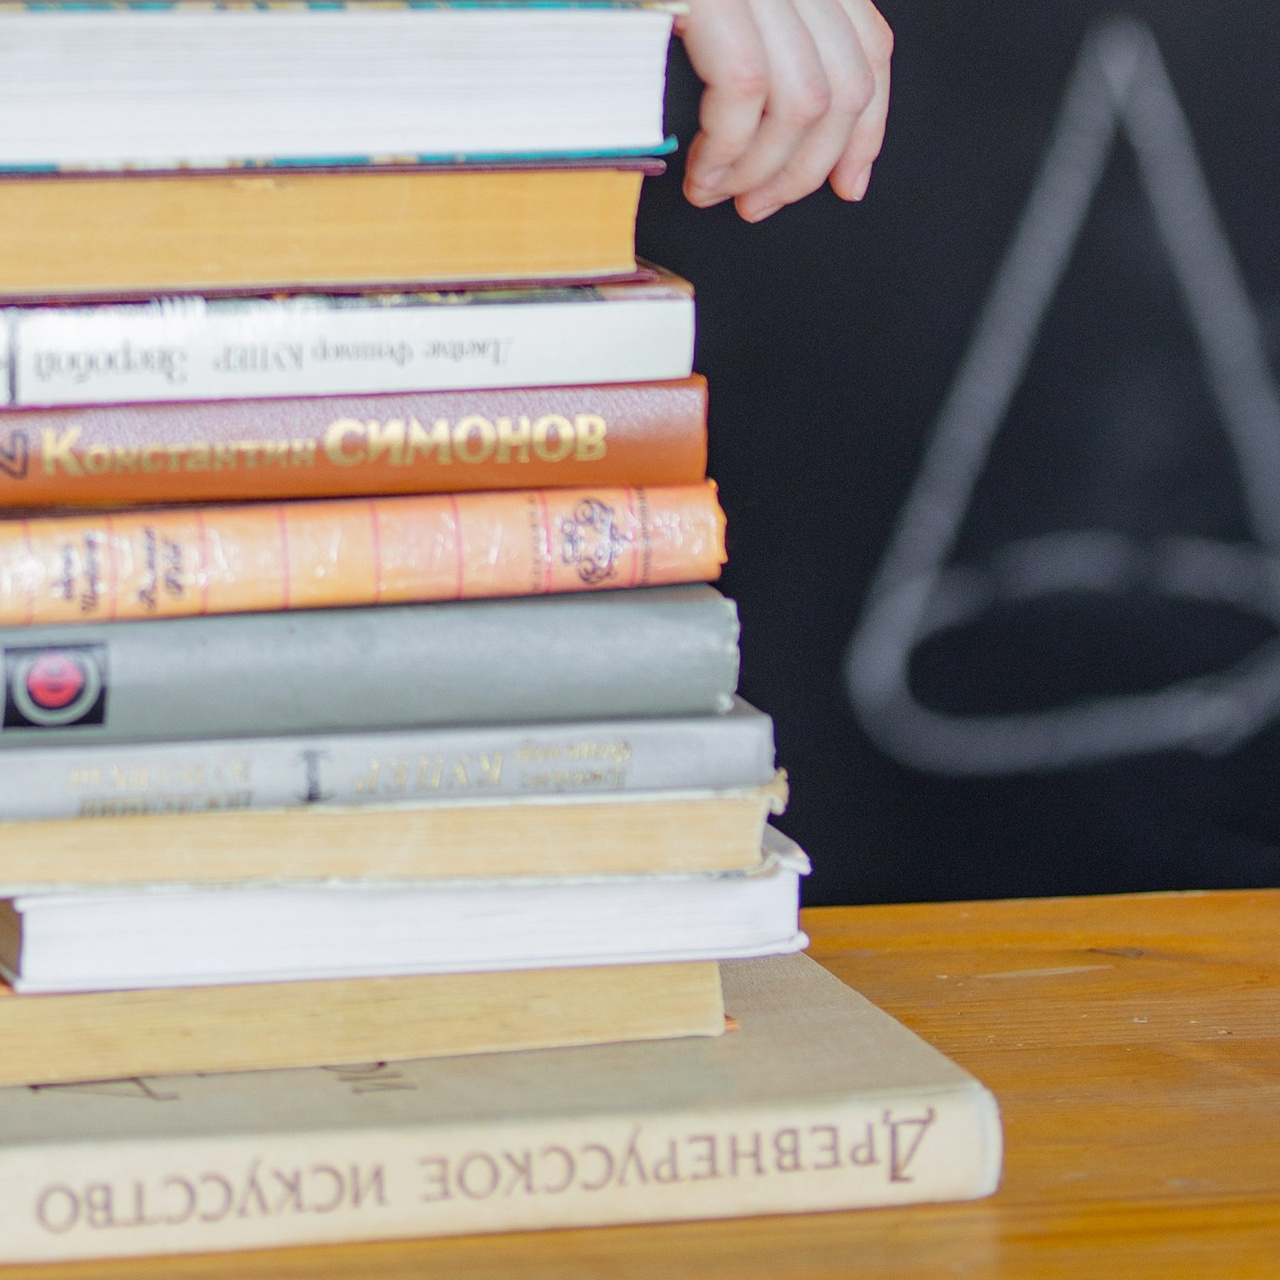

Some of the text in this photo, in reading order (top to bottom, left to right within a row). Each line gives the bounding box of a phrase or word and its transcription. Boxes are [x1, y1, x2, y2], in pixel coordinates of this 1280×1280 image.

[33, 339, 189, 385] Зверобой
[323, 413, 608, 467] СИМОНОВ
[35, 1106, 936, 1234] ДРЕВНЕРУССКОЕ ИСКУССТВО
